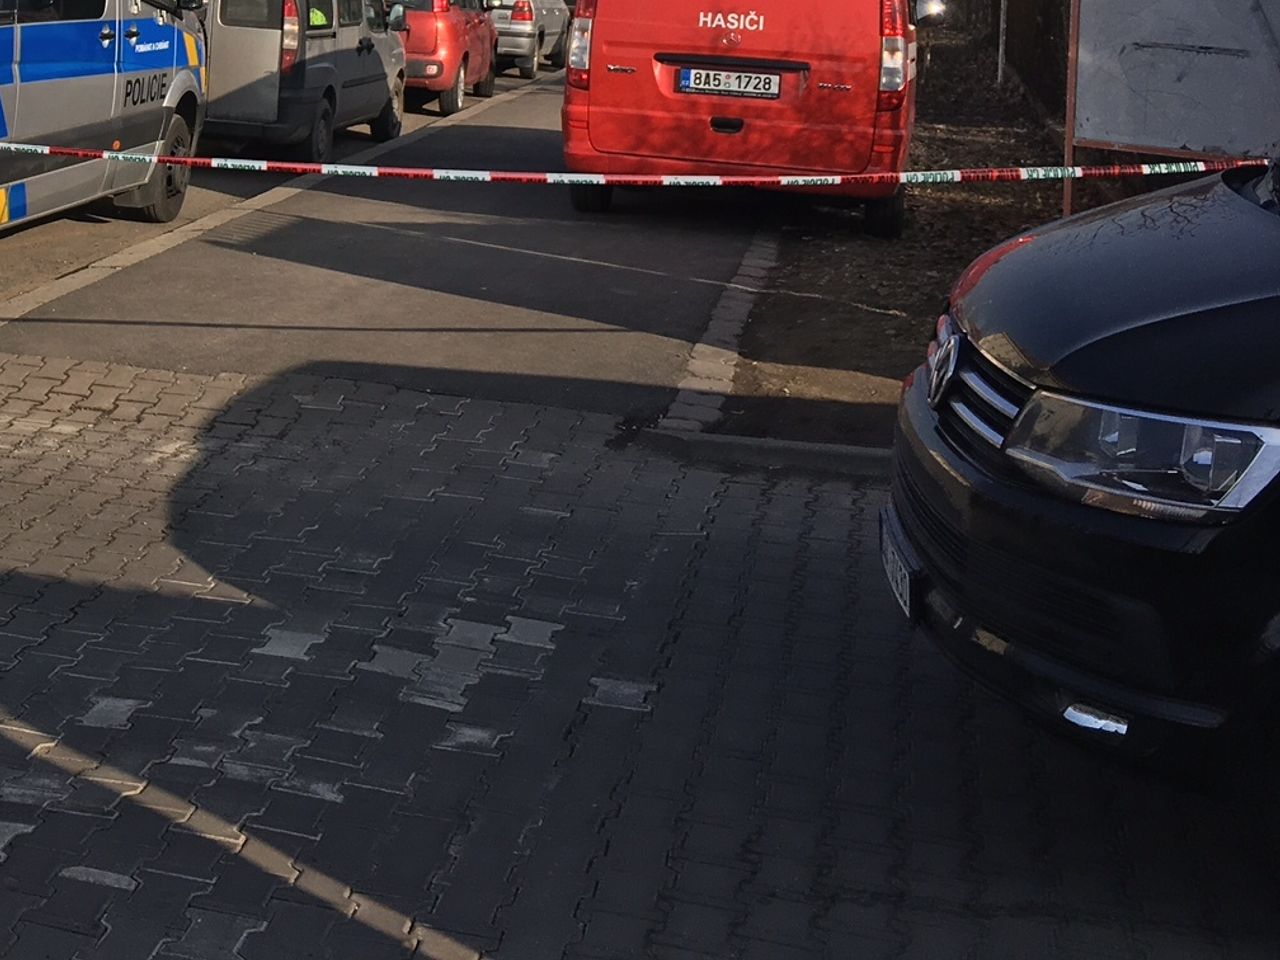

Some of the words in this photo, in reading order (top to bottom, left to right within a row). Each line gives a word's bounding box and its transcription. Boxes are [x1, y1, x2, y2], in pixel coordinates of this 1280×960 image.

[698, 10, 765, 31] HASIČI
[123, 73, 168, 108] POLICIE
[693, 72, 722, 87] 8A5
[735, 75, 772, 91] 1728
